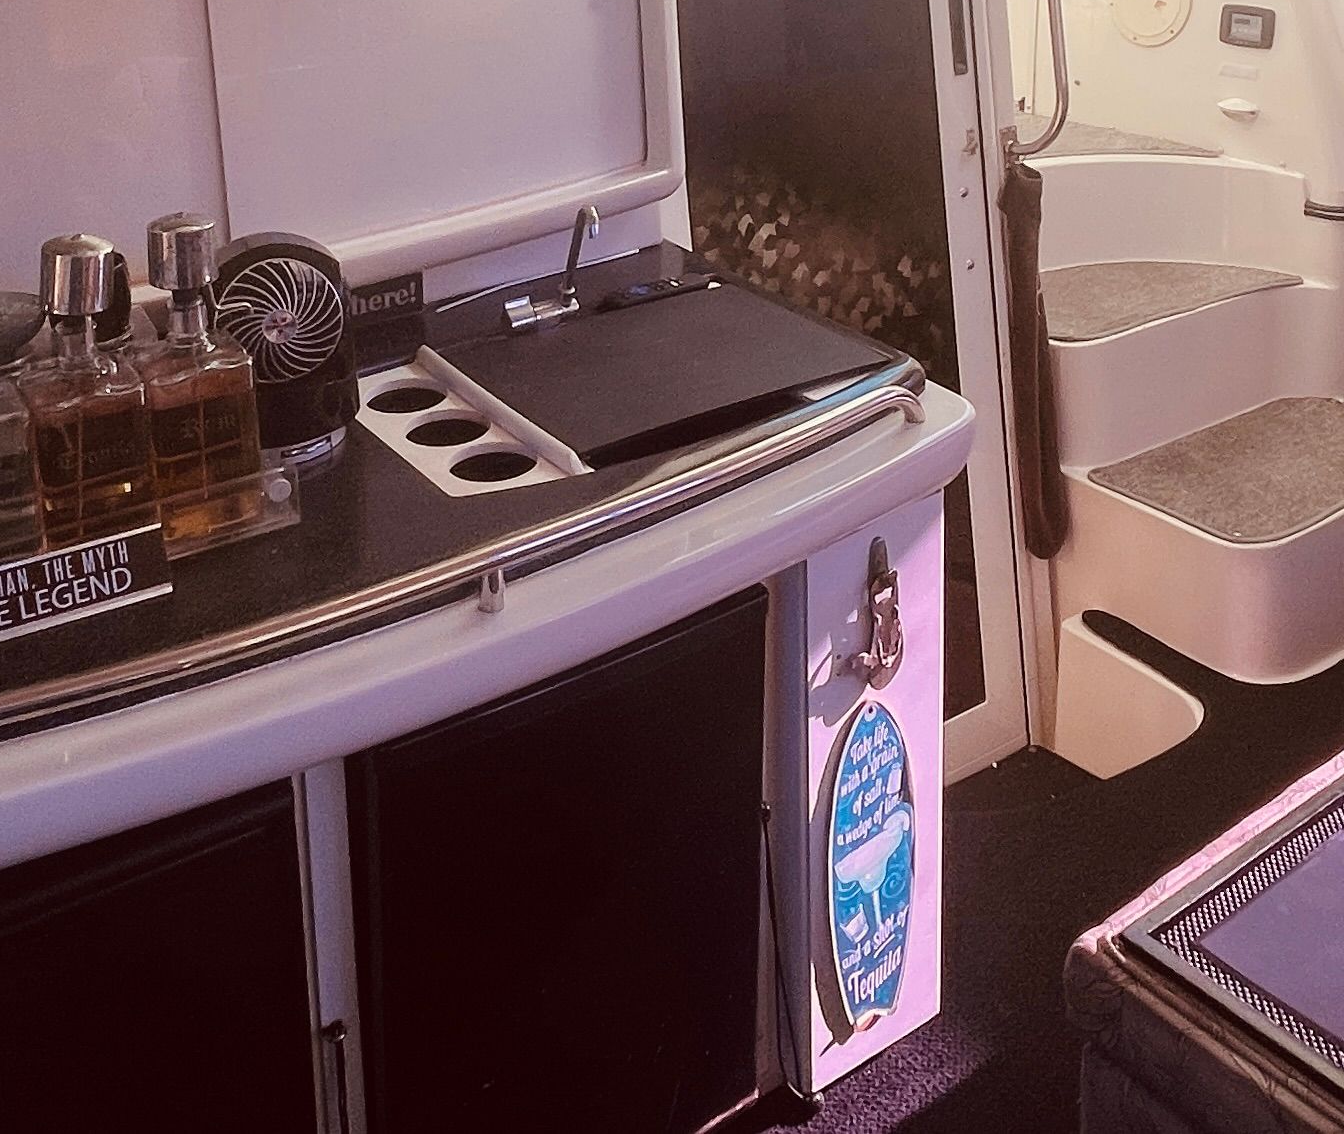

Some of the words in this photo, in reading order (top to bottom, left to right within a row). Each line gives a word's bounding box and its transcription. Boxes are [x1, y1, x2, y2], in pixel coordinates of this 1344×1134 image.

[42, 555, 75, 585] THE
[81, 540, 129, 575] MYTH
[18, 567, 132, 620] LEGEND
[852, 790, 864, 816] of
[841, 943, 862, 969] and
[847, 945, 902, 1005] Tequila
